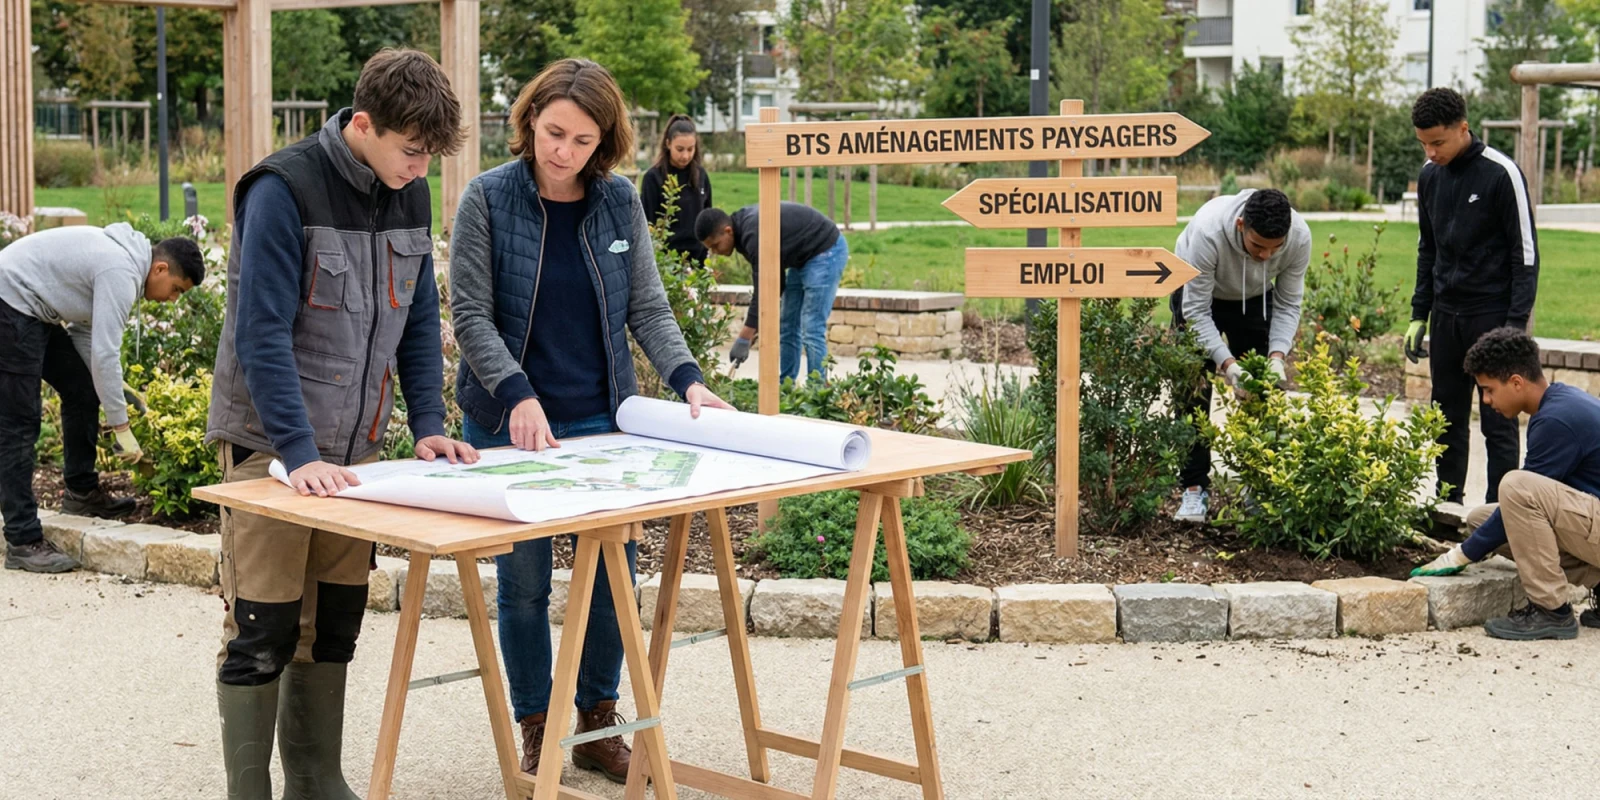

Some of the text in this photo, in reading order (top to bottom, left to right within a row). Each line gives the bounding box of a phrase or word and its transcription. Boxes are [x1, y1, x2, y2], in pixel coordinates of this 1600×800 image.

[786, 124, 1177, 156] BTS AMÉNAGEMENTS PAYSAGERS
[979, 188, 1162, 215] SPÉCIALISATION
[1020, 262, 1104, 285] EMPLOI
